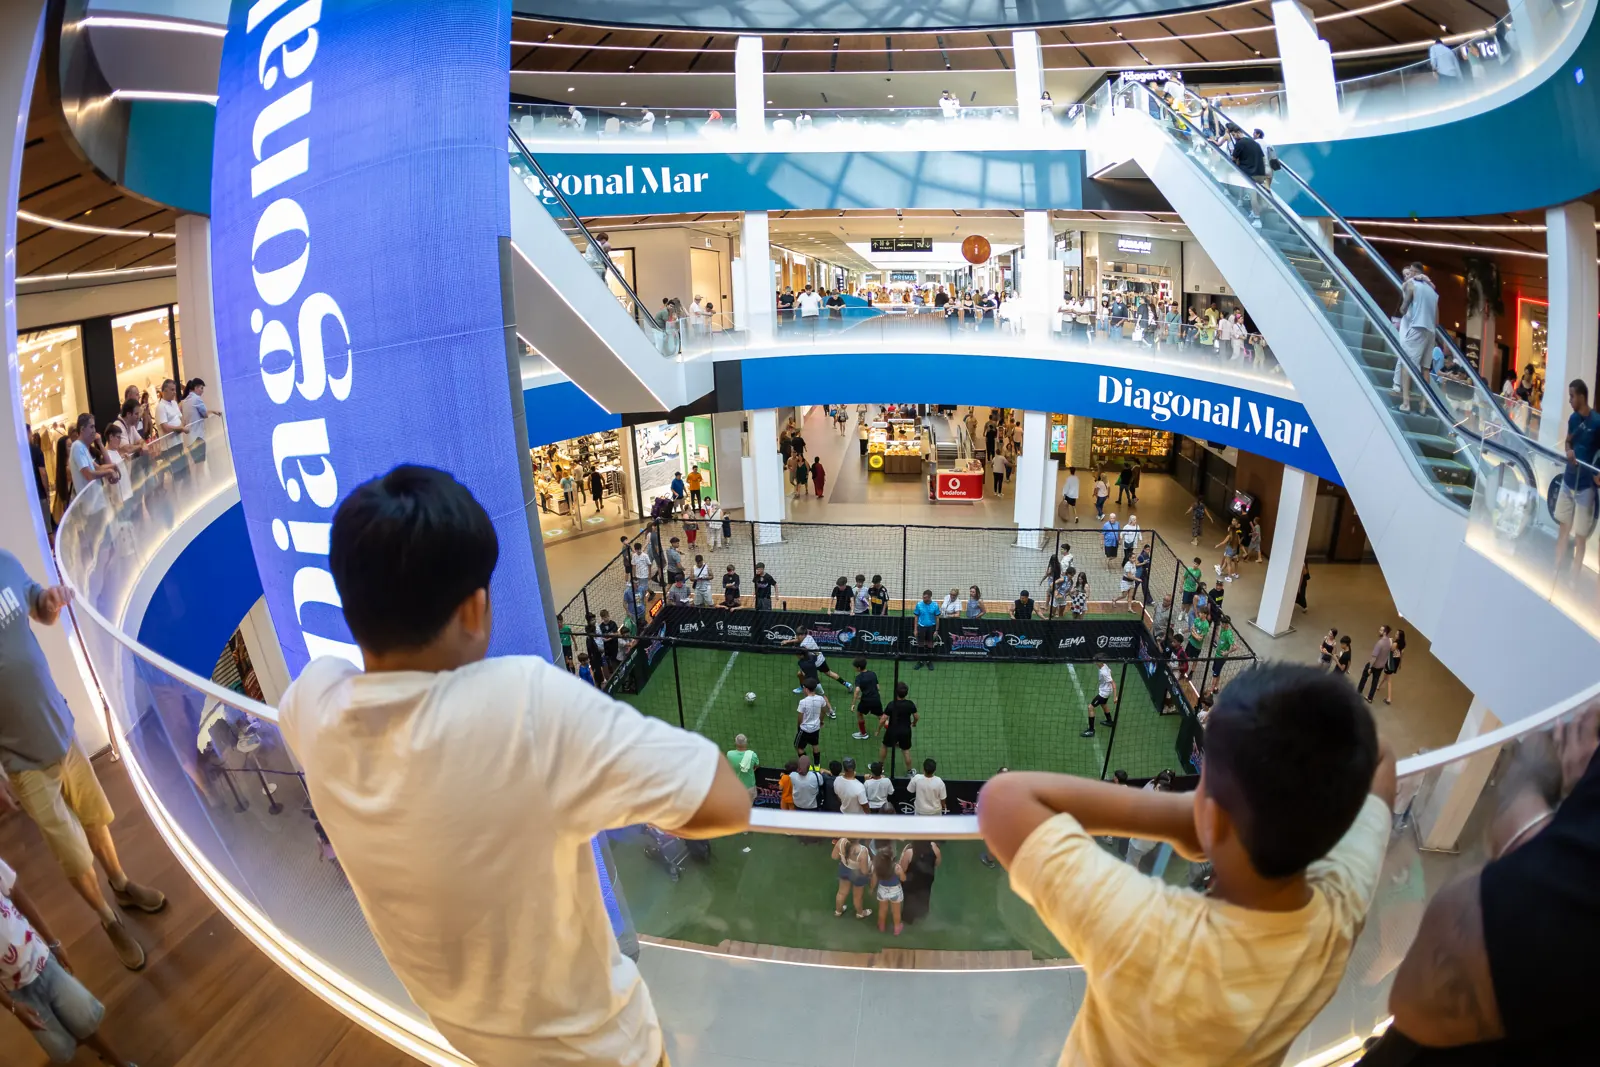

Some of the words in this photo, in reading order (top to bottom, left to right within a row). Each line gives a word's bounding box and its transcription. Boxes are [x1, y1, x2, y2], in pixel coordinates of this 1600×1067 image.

[641, 166, 709, 194] Mar
[1098, 375, 1241, 429] Diagonal
[1244, 401, 1309, 448] Mar
[1059, 636, 1086, 646] LEMA
